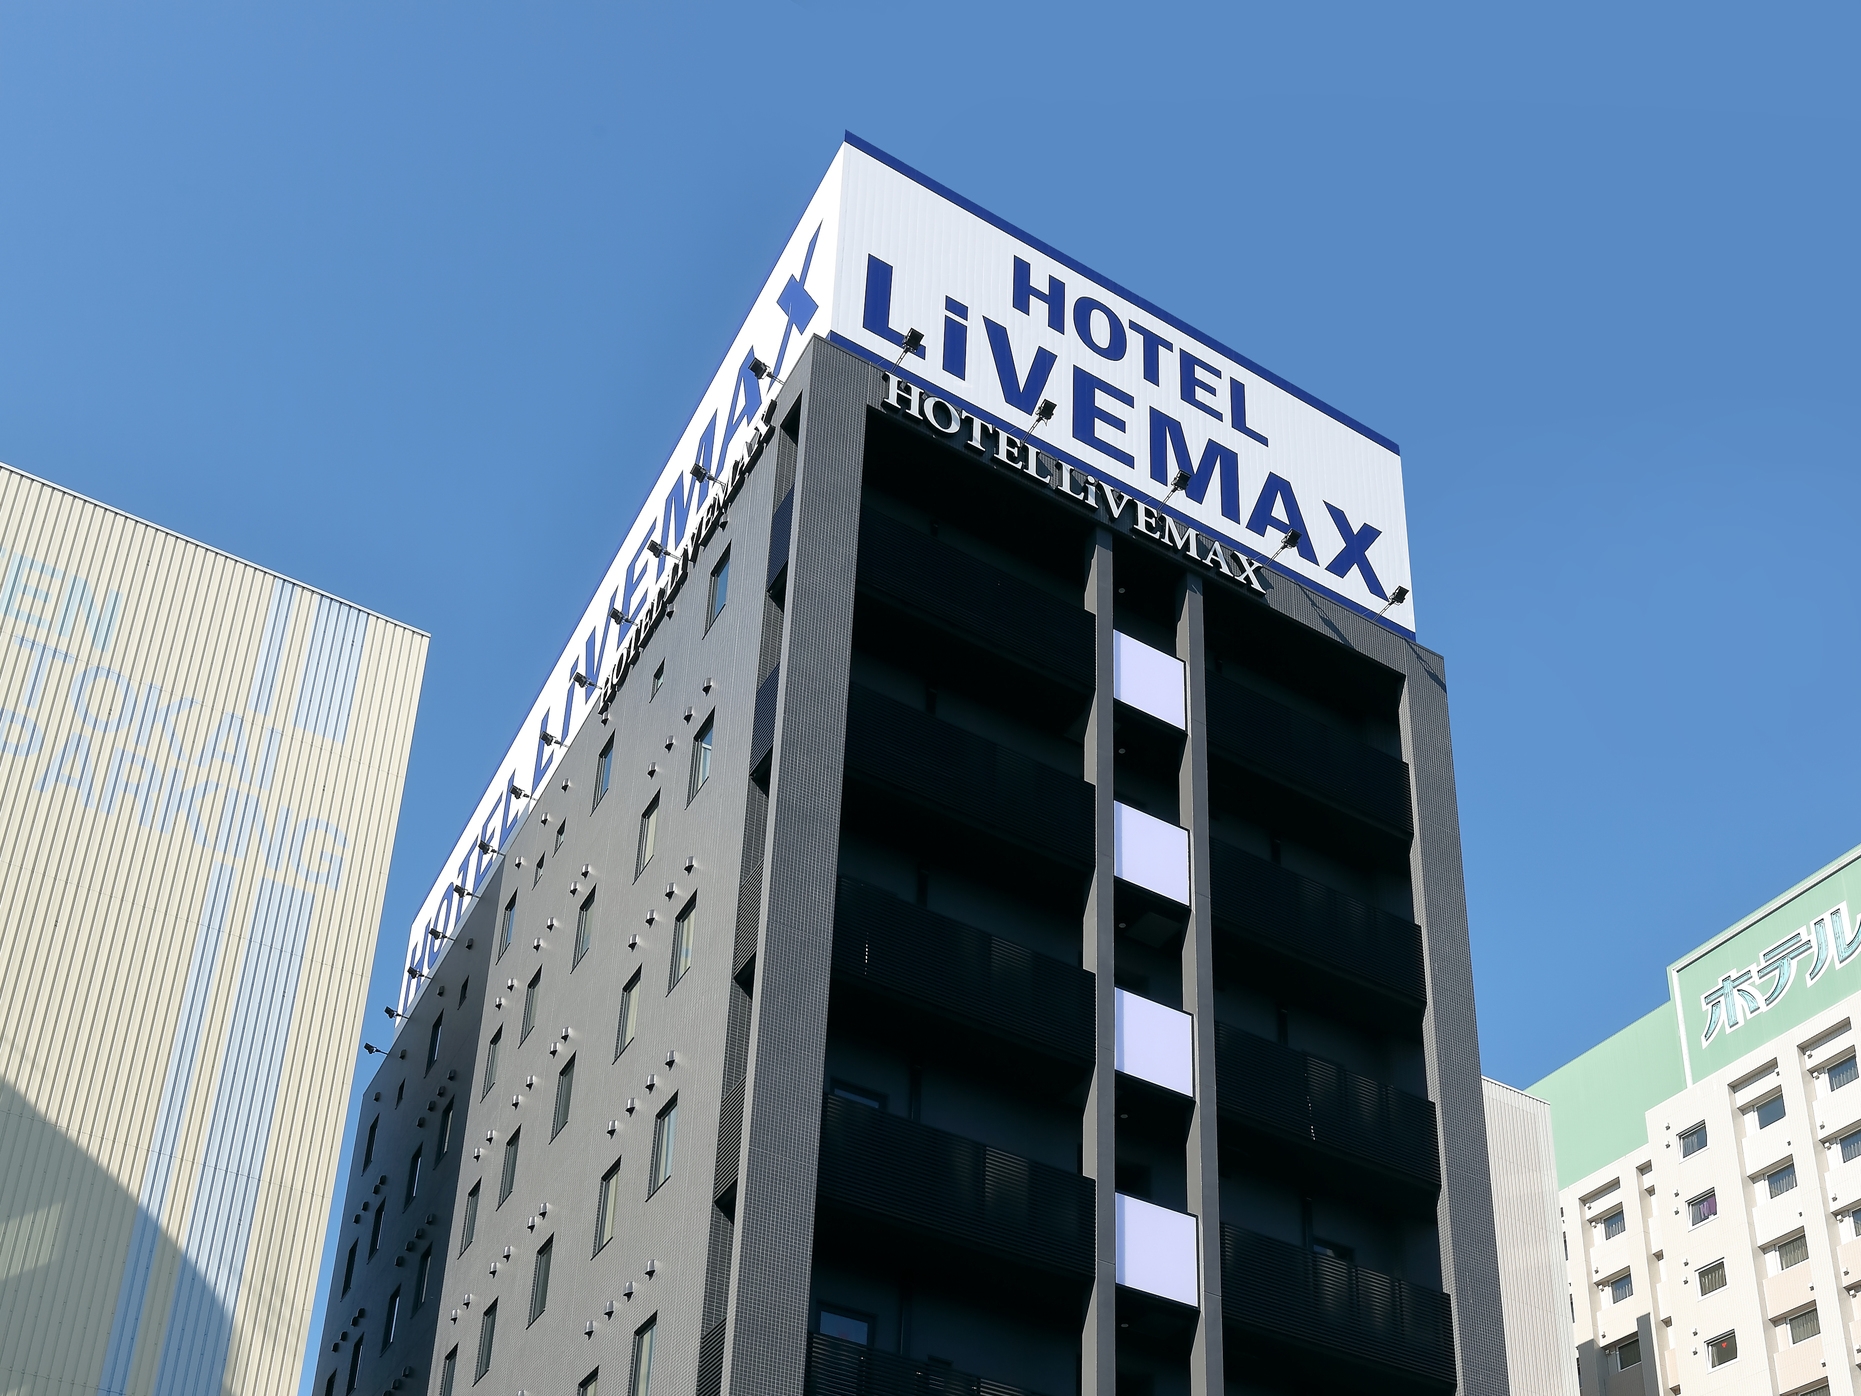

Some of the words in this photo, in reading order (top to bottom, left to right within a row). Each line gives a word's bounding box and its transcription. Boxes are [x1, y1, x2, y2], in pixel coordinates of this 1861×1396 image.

[862, 252, 1391, 603] LiVEMAX
[1012, 254, 1269, 448] HOTEL
[882, 371, 1051, 485] HOTEL
[1057, 459, 1269, 595] LiVEMAX
[0, 708, 350, 892] PARKING
[13, 632, 284, 792] TOKAI
[401, 767, 521, 1016] HOTEL
[1700, 901, 1861, 1049] ホテル
